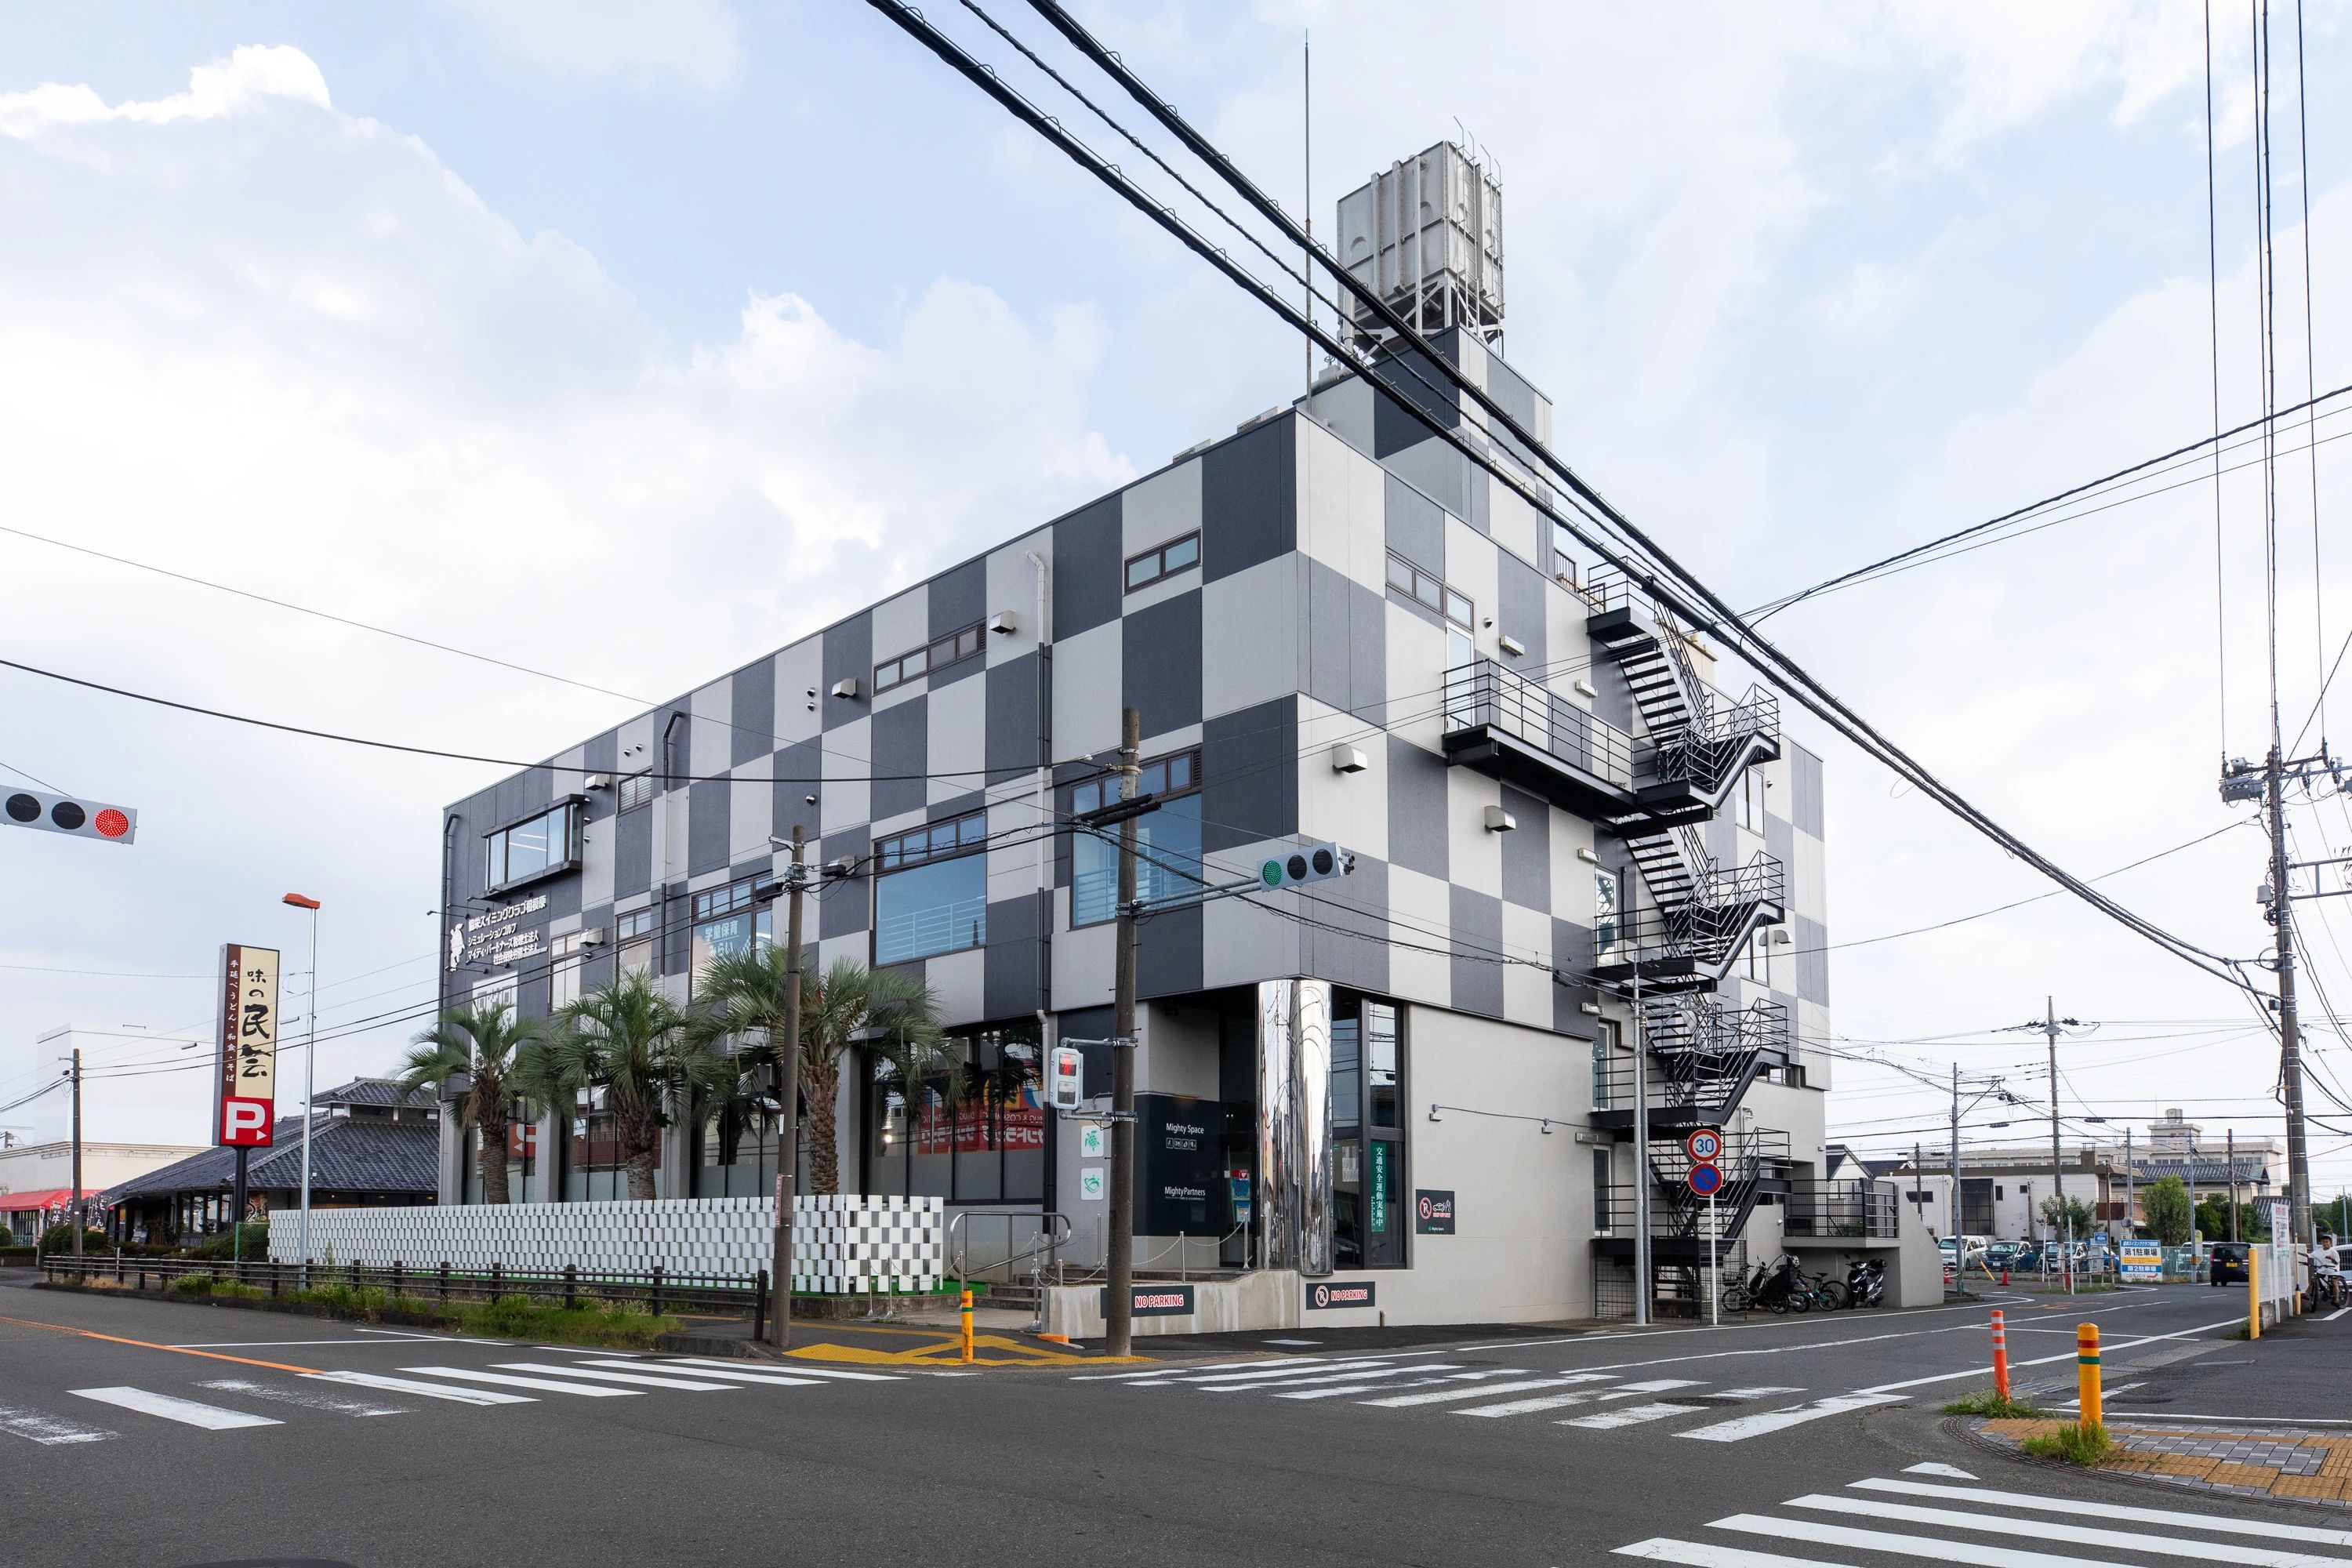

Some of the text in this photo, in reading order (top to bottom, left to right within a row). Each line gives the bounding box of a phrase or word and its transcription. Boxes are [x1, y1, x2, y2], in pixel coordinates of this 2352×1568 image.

[468, 923, 517, 947] シミュレーションゴルフ
[705, 920, 739, 942] 学童保育
[226, 959, 239, 1082] 手延べうどん・和食・そば
[239, 968, 273, 1078] 味の民芸
[225, 1101, 266, 1140] P
[1166, 1123, 1204, 1134] Mighty Space
[1695, 1138, 1715, 1153] 30
[1375, 1146, 1384, 1227] 交通安全運動実施中
[1135, 1294, 1184, 1308] NO PARKING
[1330, 1289, 1368, 1301] NO PARKING
